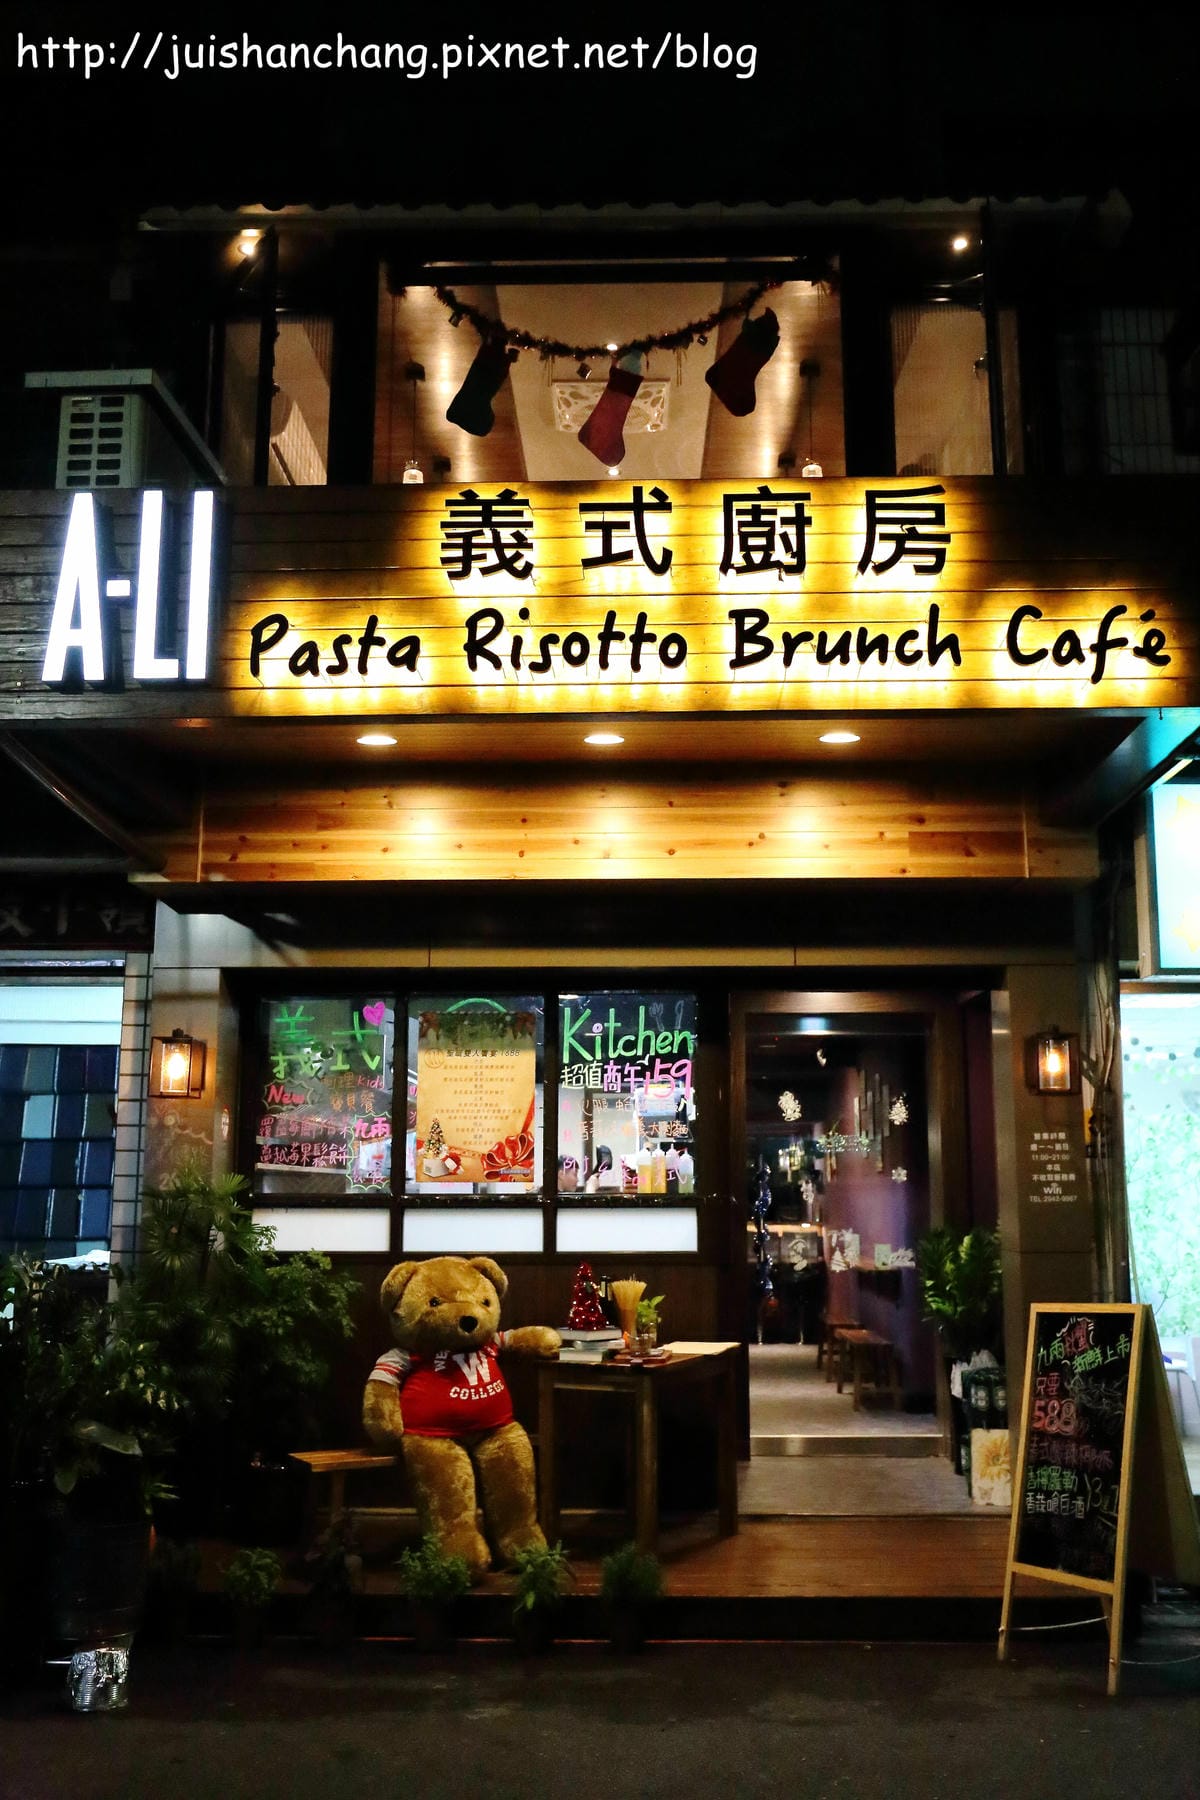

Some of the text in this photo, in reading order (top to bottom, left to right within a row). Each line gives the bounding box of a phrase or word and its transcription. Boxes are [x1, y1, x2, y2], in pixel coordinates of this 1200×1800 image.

[440, 484, 952, 580] 義式廚房
[41, 489, 214, 682] A-LI
[249, 603, 1172, 684] Pasta Risotto Brunch Café
[562, 1005, 694, 1064] Kitchen
[267, 1085, 306, 1105] New
